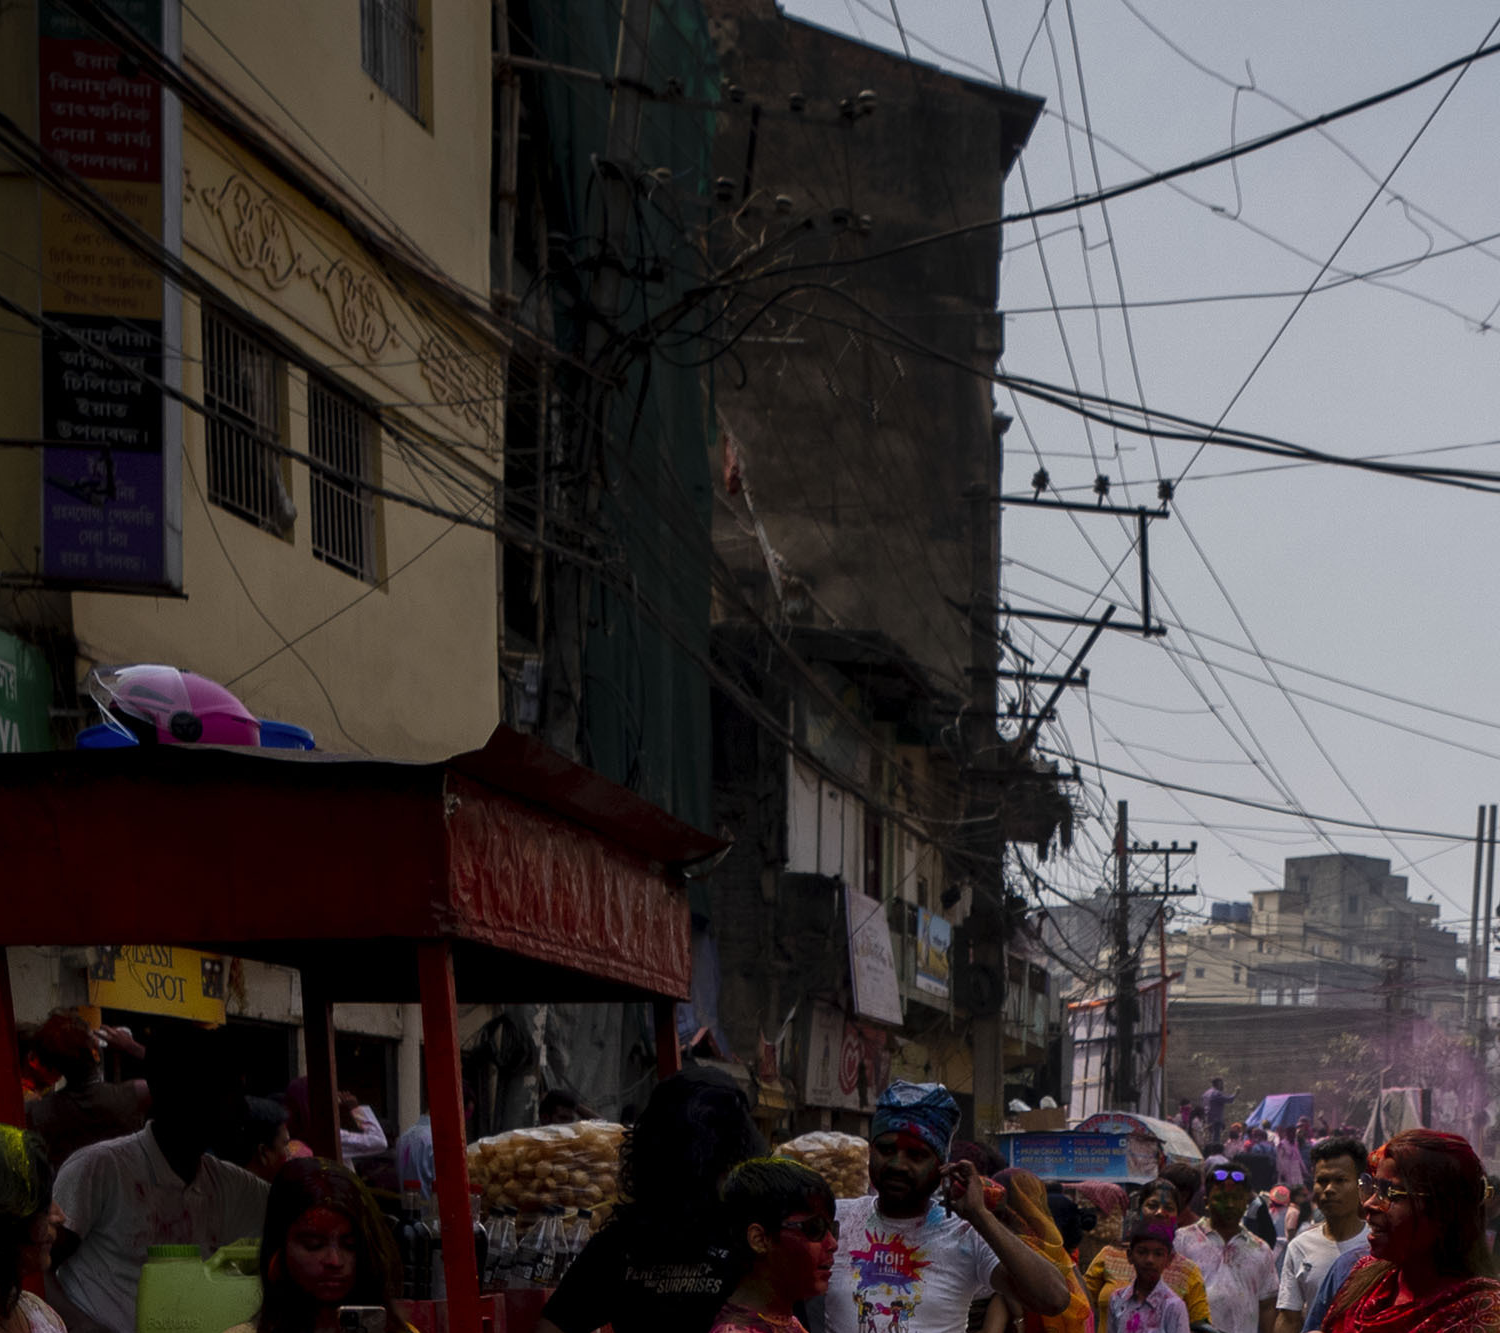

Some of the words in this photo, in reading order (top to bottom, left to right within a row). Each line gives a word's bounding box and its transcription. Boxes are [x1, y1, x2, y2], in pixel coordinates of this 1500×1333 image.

[146, 971, 188, 1004] SPOT
[873, 1250, 906, 1266] Holi
[656, 1277, 723, 1294] SURPRISES
